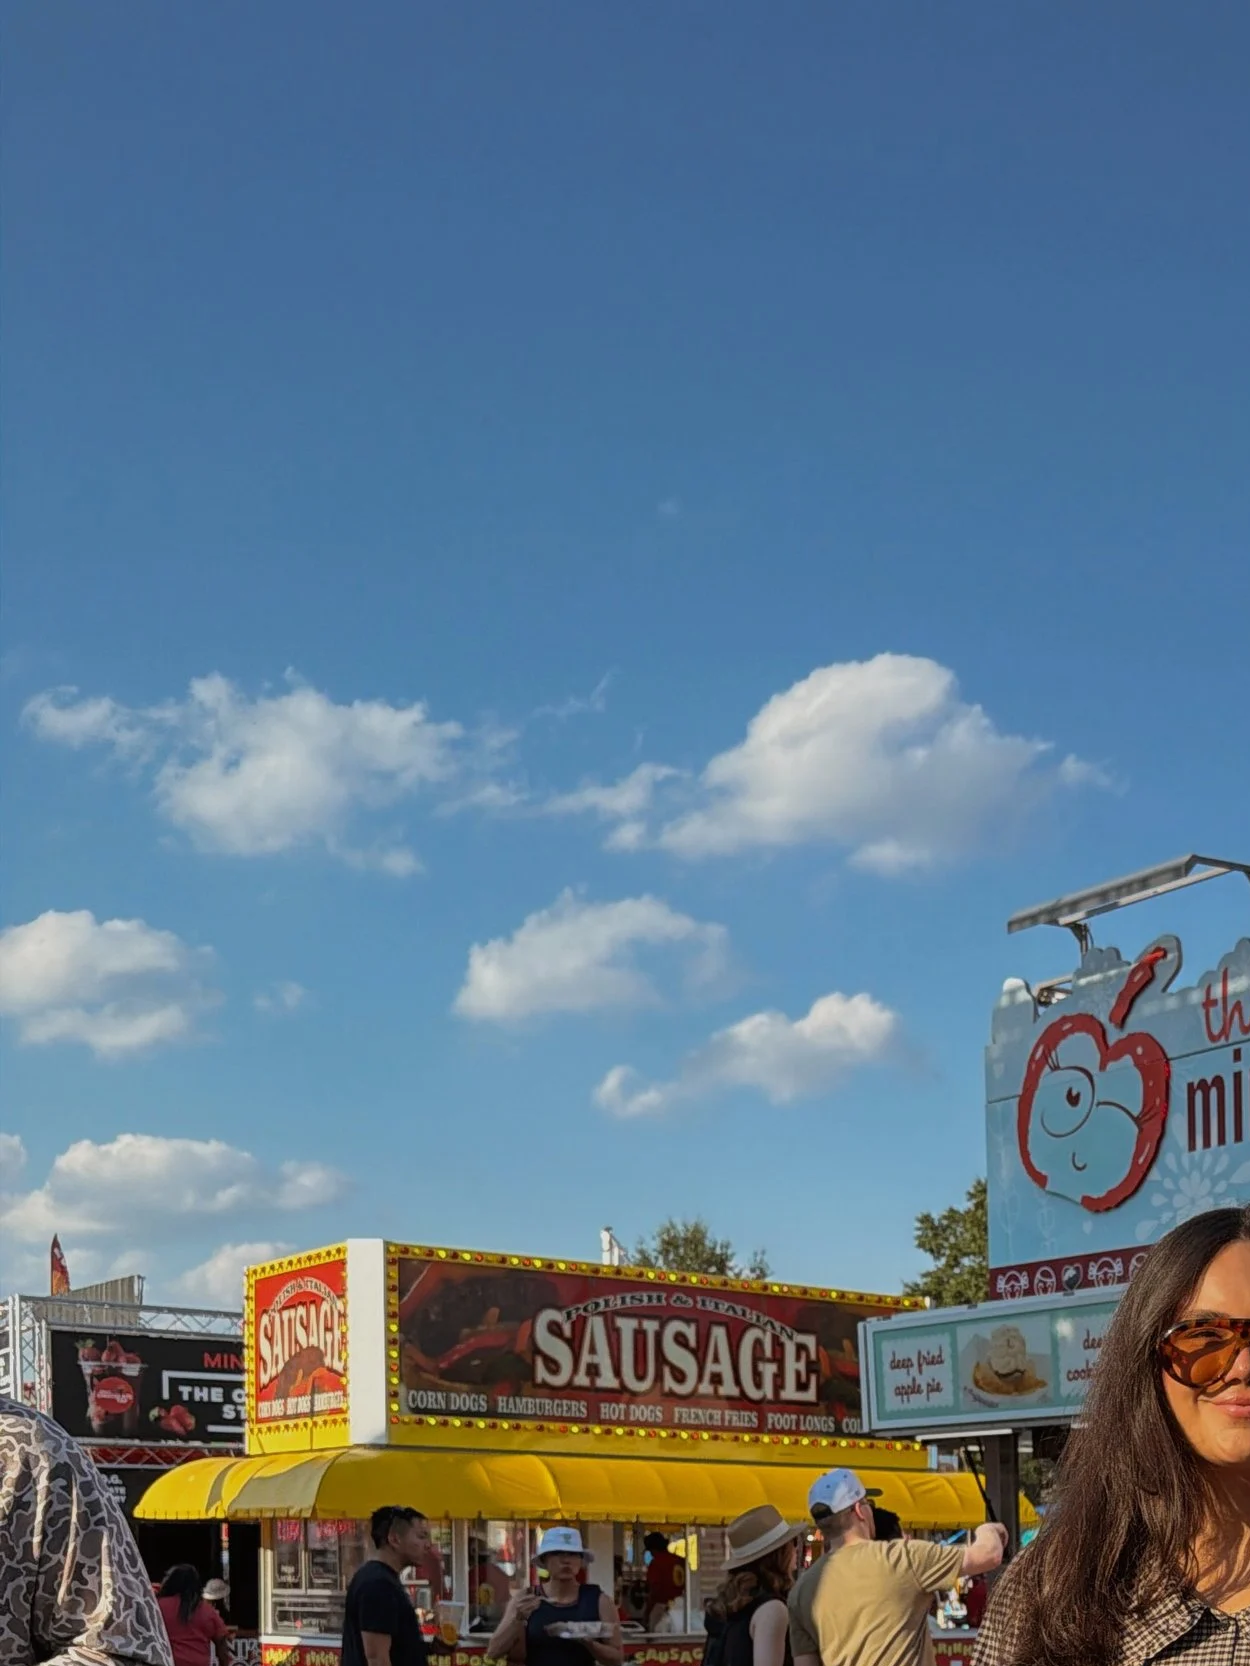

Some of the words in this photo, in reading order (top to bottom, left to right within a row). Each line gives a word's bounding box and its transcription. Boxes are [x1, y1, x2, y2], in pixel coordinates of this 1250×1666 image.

[563, 1293, 666, 1324] POLISH
[671, 1293, 693, 1308] &
[697, 1296, 800, 1342] ITALIAN
[259, 1299, 345, 1387] SAUSAGE
[535, 1308, 818, 1403] SAUSAGE
[890, 1352, 913, 1377] deep
[917, 1345, 945, 1375] fried
[179, 1385, 224, 1403] THE
[408, 1389, 447, 1410] CORN
[449, 1393, 488, 1412] DOGS
[497, 1396, 588, 1418] HAMBURGERS
[600, 1403, 625, 1421] HOT
[629, 1404, 663, 1423] DOGS
[674, 1407, 721, 1425] FRENCH
[724, 1410, 759, 1428] FRIES
[767, 1413, 797, 1430] FOOT
[800, 1415, 836, 1433] LONGS
[894, 1378, 924, 1403] apple
[926, 1380, 944, 1401] pie
